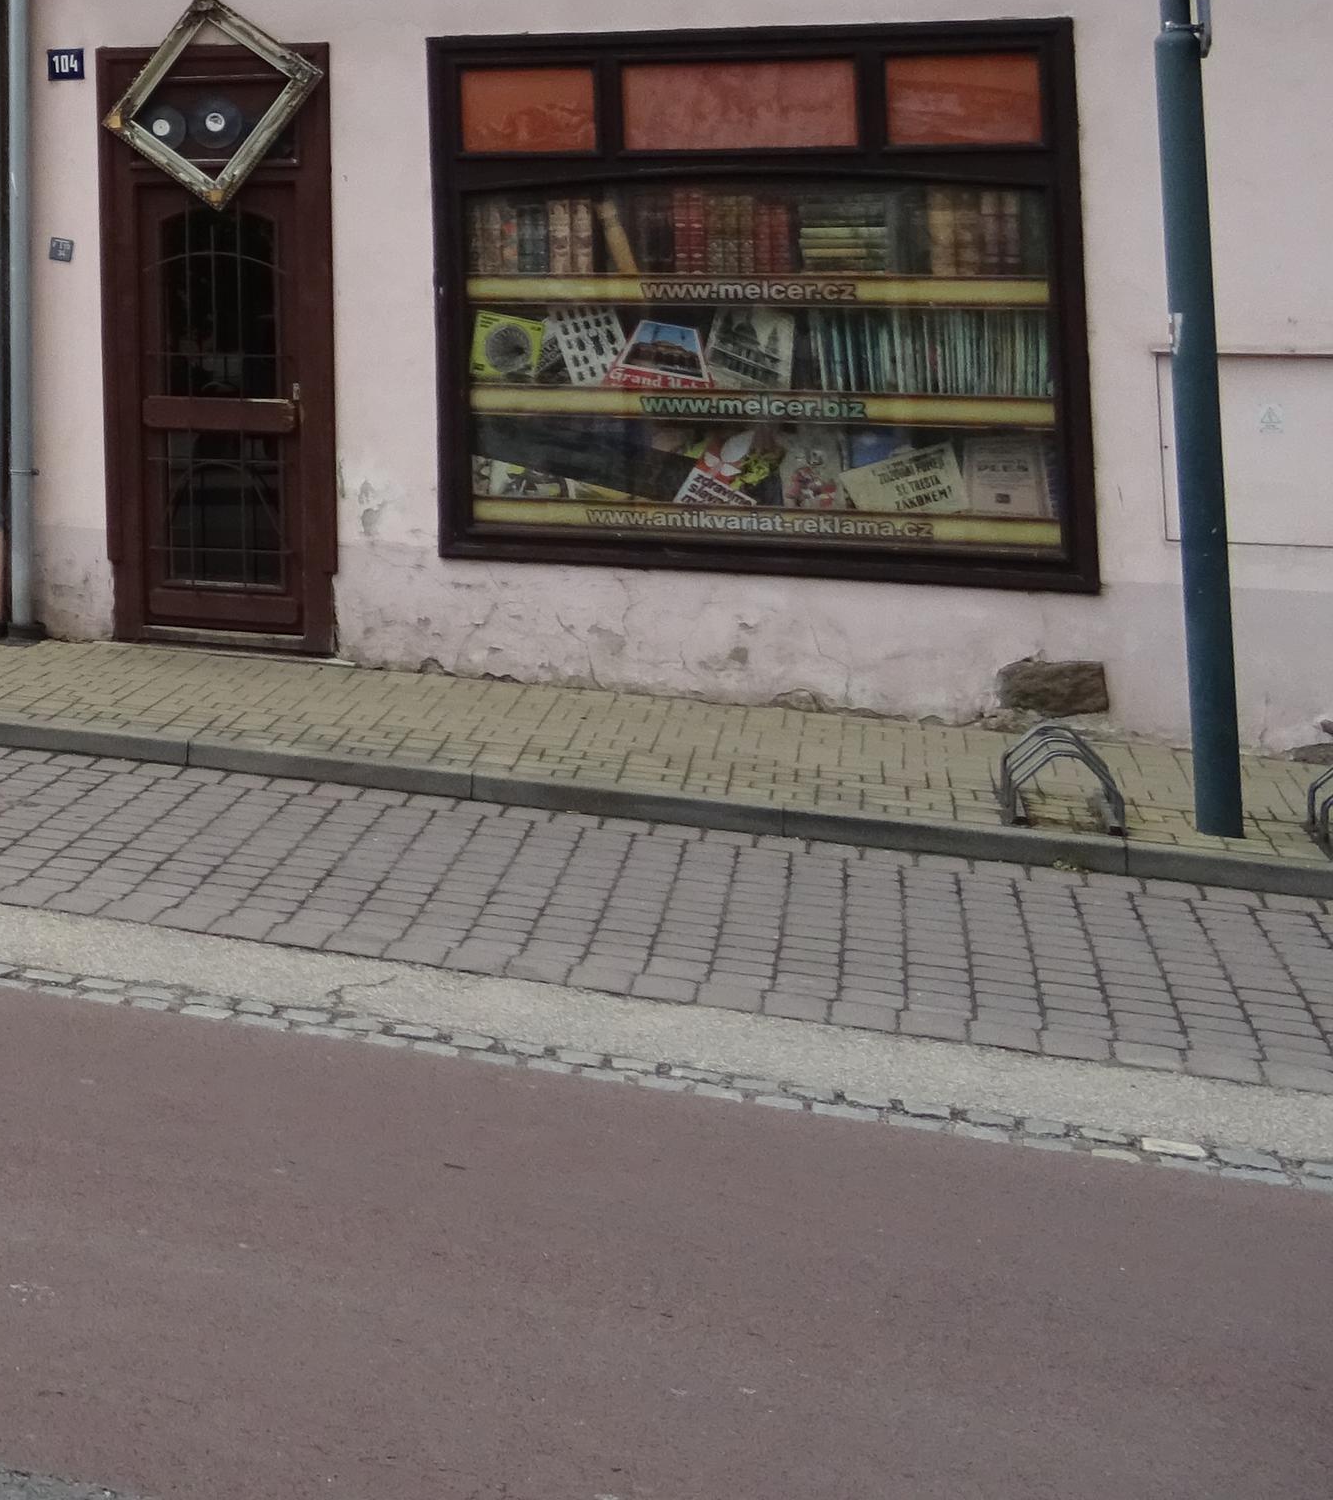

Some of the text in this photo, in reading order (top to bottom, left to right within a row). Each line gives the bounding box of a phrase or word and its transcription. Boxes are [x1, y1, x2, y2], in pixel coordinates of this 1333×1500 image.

[52, 54, 79, 73] 104
[640, 279, 857, 301] www.melcer.cz
[640, 392, 866, 418] www.melcer.biz
[586, 507, 934, 538] www.antikvariat-reklama.cz
